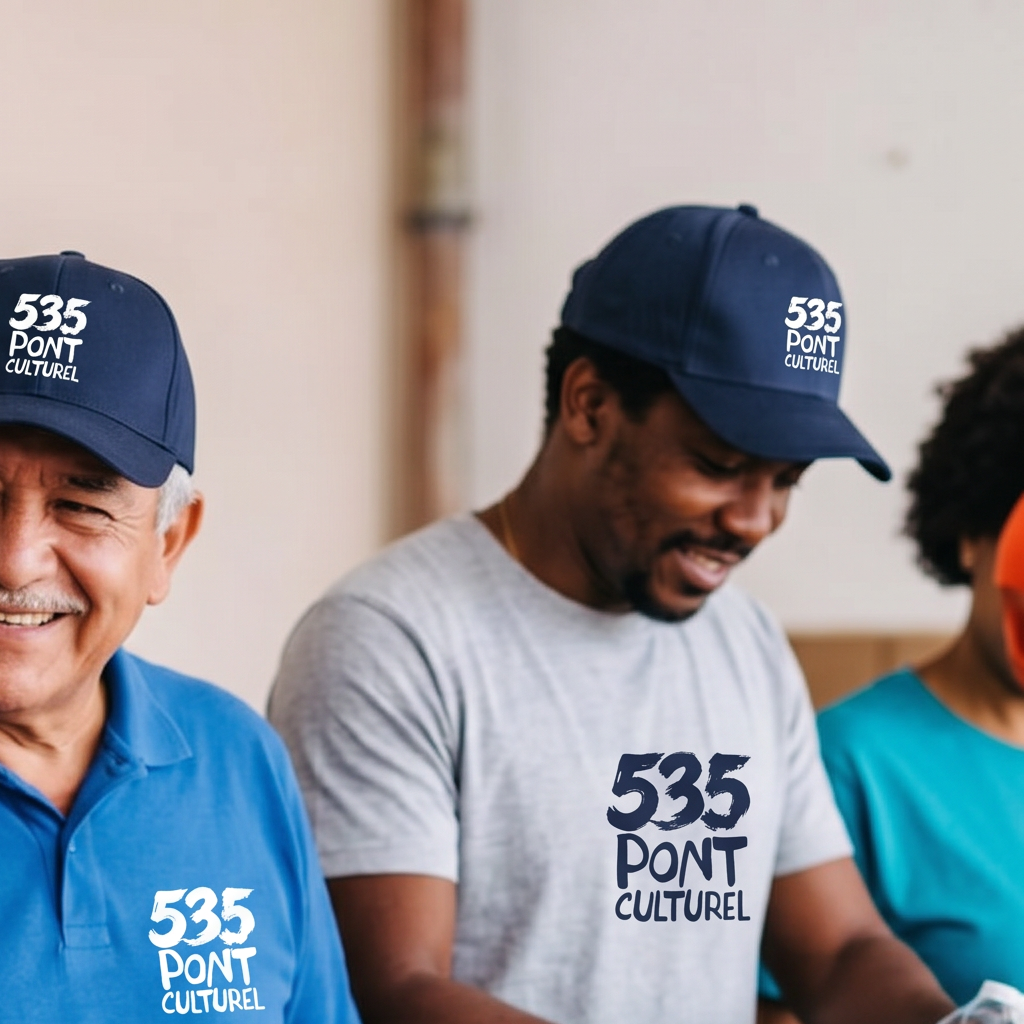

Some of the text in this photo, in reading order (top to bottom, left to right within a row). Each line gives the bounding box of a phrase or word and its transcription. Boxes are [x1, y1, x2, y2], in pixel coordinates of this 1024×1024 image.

[9, 294, 90, 335] 535
[785, 296, 843, 334] 535
[9, 331, 83, 363] PONT
[786, 329, 840, 358] PONT
[5, 358, 79, 383] CULTUREL
[784, 353, 840, 375] CULTUREL
[607, 752, 751, 832] 535
[617, 832, 748, 889] PONT
[149, 887, 255, 948] 535
[615, 889, 751, 923] CULTUREL
[158, 946, 257, 990] PONT
[161, 986, 265, 1015] CULTUREL
